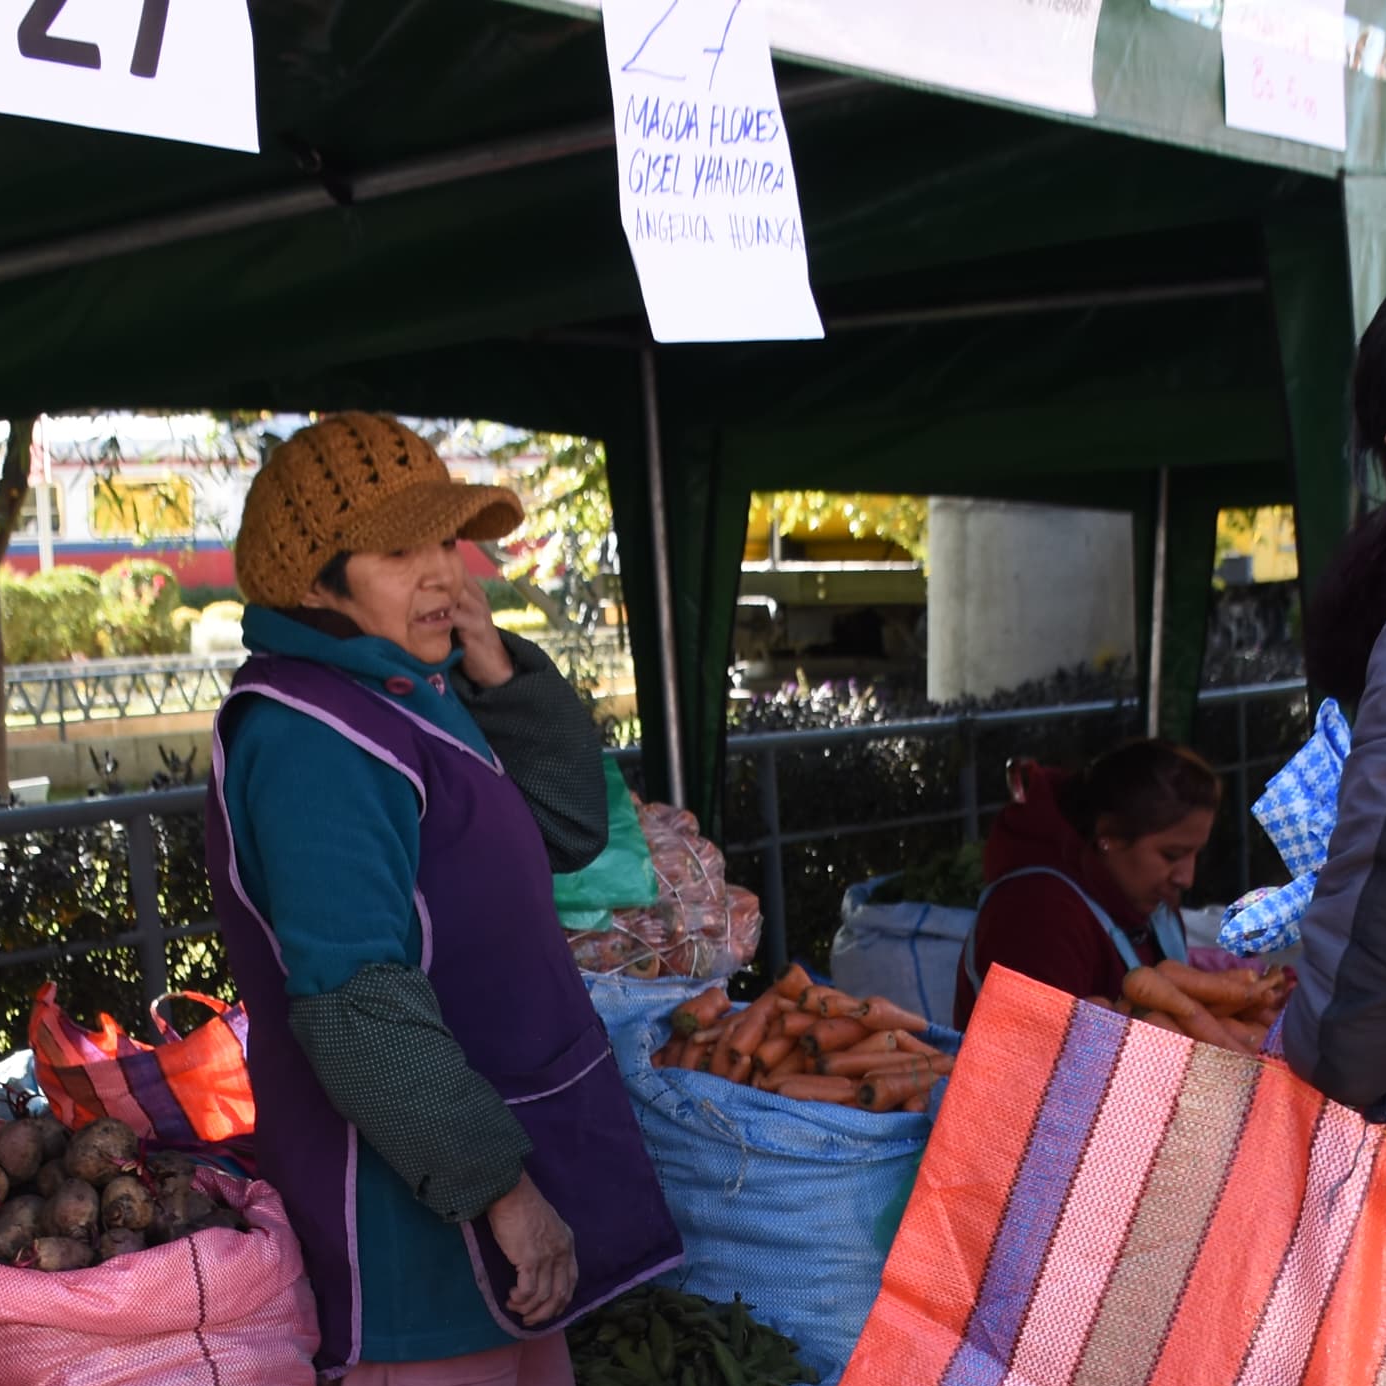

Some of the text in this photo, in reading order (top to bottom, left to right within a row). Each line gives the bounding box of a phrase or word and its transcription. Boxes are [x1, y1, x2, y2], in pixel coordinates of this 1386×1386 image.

[624, 94, 779, 148] MAGDA FLORES
[628, 147, 683, 197] GISEL
